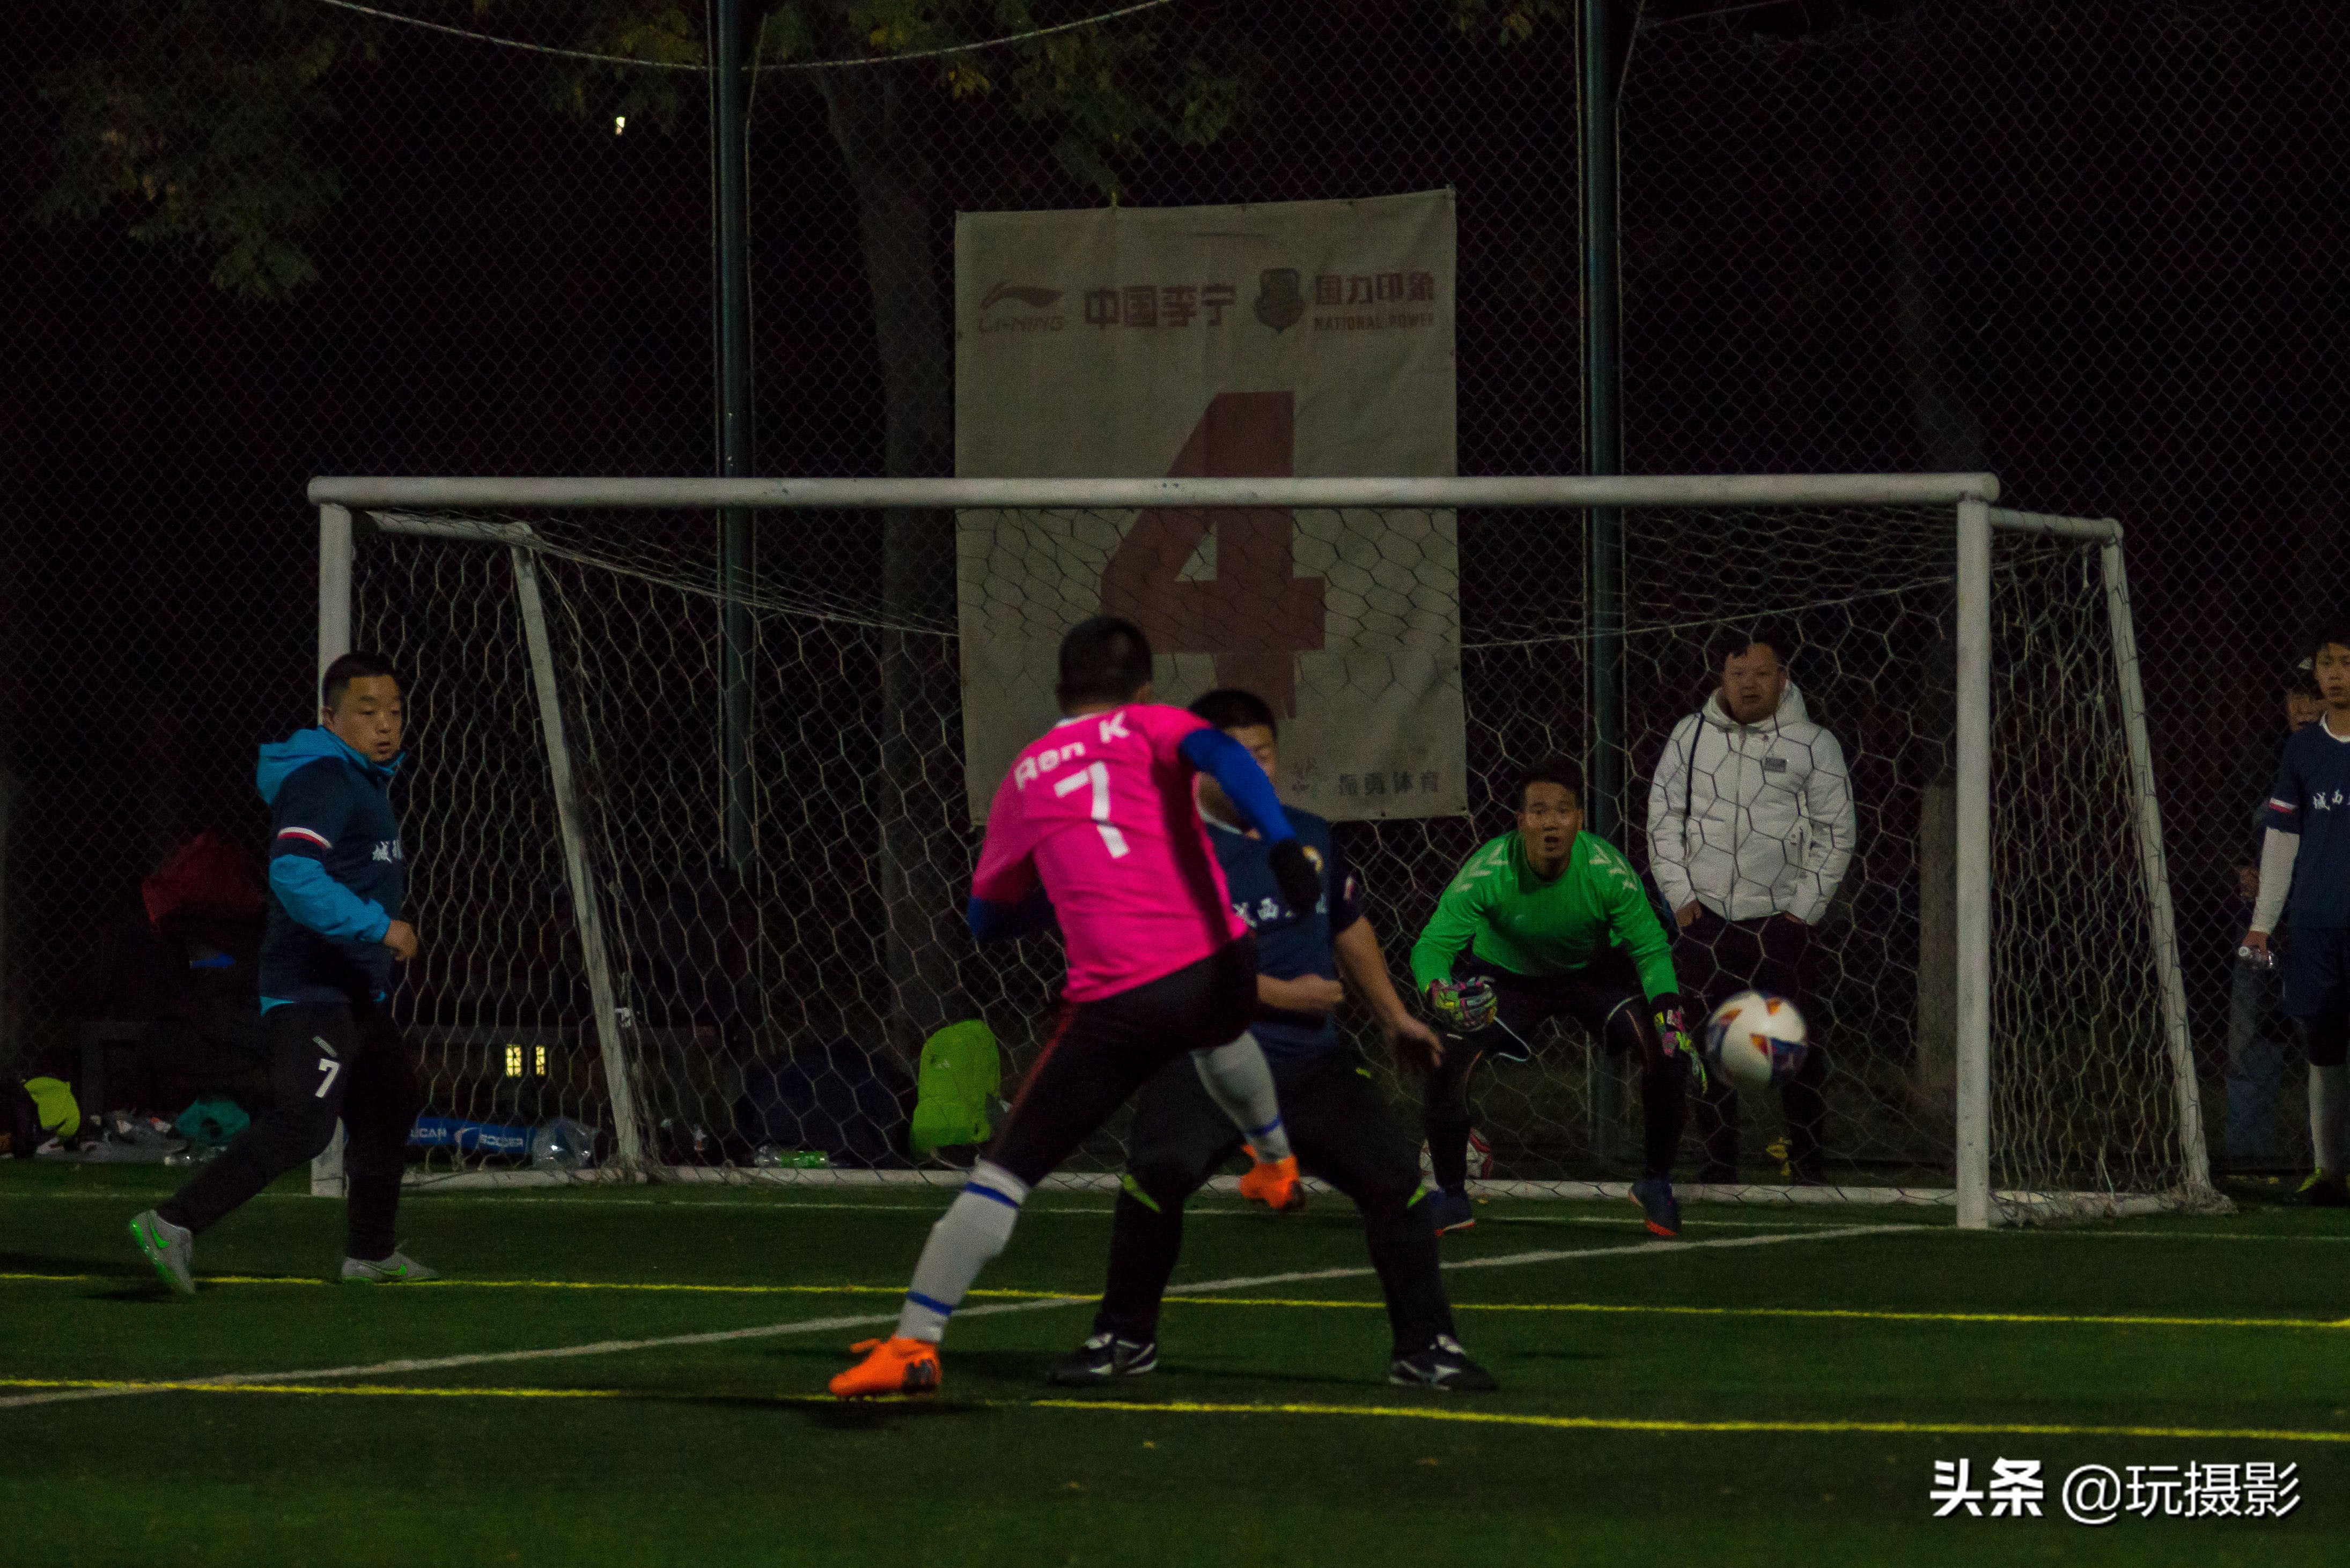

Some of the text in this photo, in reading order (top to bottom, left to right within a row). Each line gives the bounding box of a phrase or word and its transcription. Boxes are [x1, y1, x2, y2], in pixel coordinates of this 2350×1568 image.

[1084, 284, 1236, 329] 中国李宁
[1315, 272, 1434, 305] 国力印象
[978, 316, 1065, 334] LI-NING
[1314, 314, 1434, 331] NATIONAL POWER
[1101, 391, 1325, 719] 4
[1098, 710, 1131, 744] K
[1052, 759, 1131, 860] 7
[315, 1058, 341, 1099] 7
